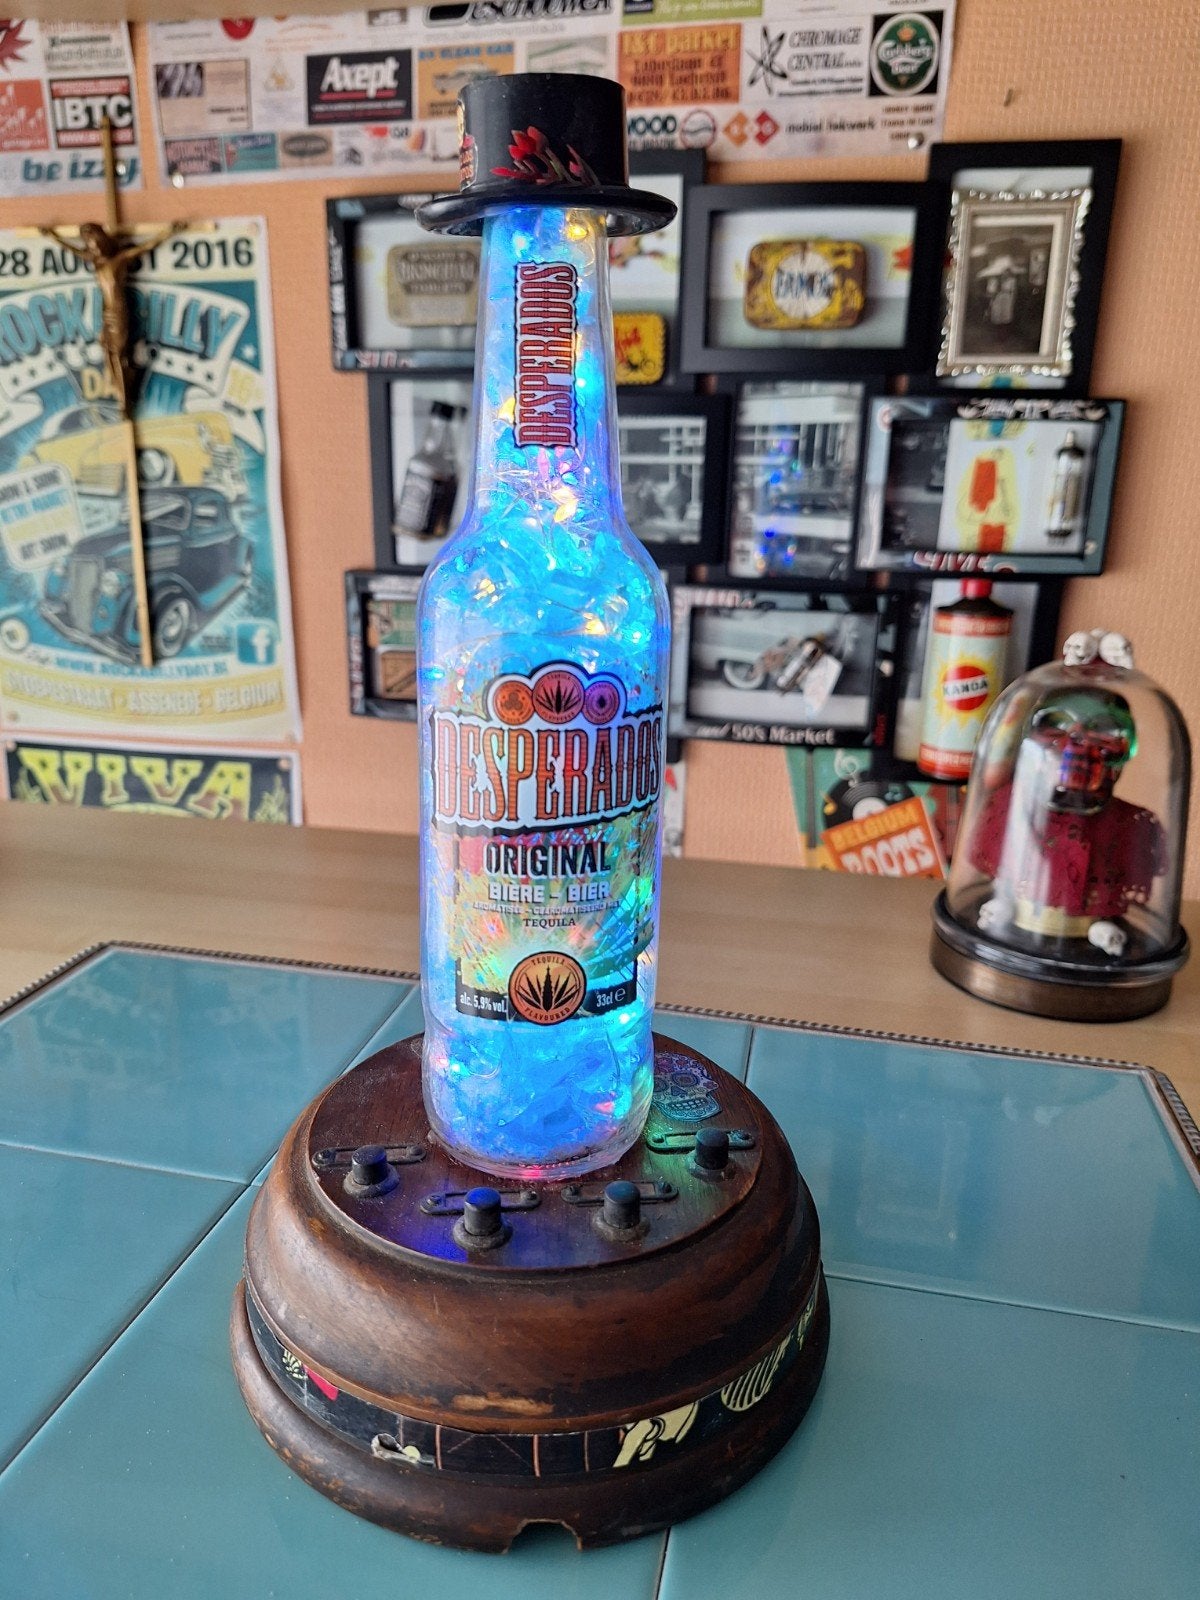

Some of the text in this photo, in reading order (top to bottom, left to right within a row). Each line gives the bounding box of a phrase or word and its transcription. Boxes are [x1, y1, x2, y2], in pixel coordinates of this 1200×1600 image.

[320, 56, 400, 99] Axept
[54, 94, 133, 131] IBTC
[172, 237, 255, 269] 2016
[518, 263, 576, 445] DESPERADOS
[769, 725, 836, 745] Market
[18, 747, 251, 820] VIVA
[437, 717, 661, 822] DESPERADOS
[485, 841, 612, 878] ORIGINAL
[567, 881, 612, 903] BIER
[523, 918, 576, 929] TEQUILA
[531, 956, 567, 967] TEQUILA
[524, 1006, 571, 1022] FLAVOURED
